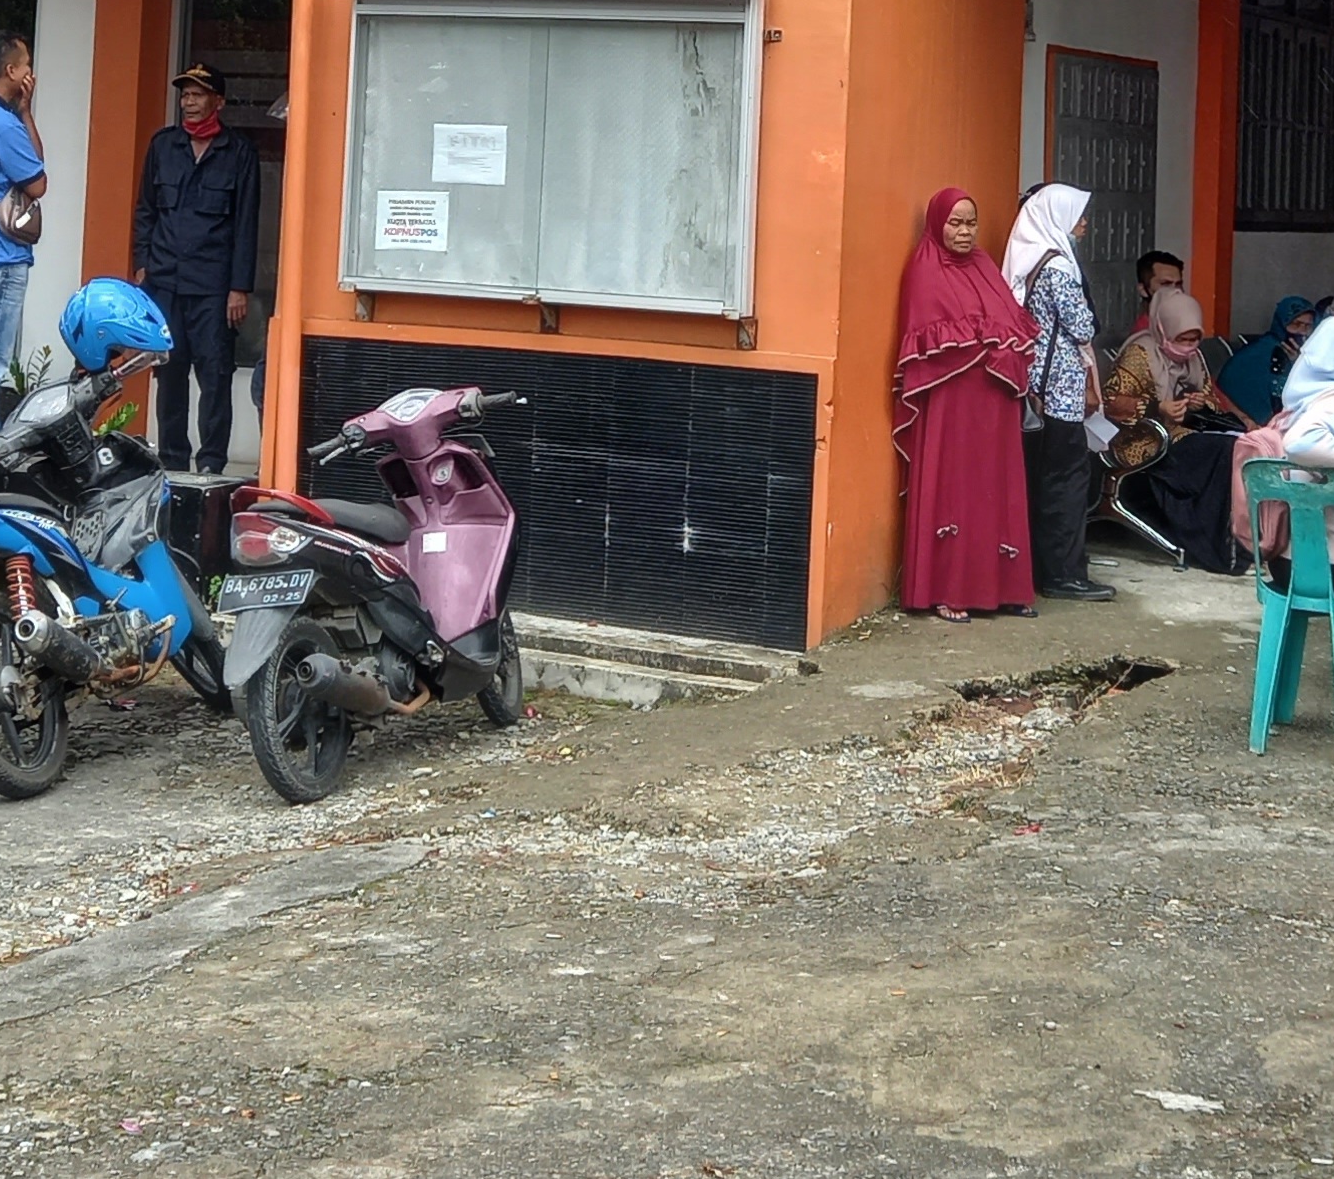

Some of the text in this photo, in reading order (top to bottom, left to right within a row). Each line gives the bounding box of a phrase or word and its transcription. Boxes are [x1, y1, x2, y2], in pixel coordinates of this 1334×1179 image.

[225, 573, 310, 594] BA 6785 DV
